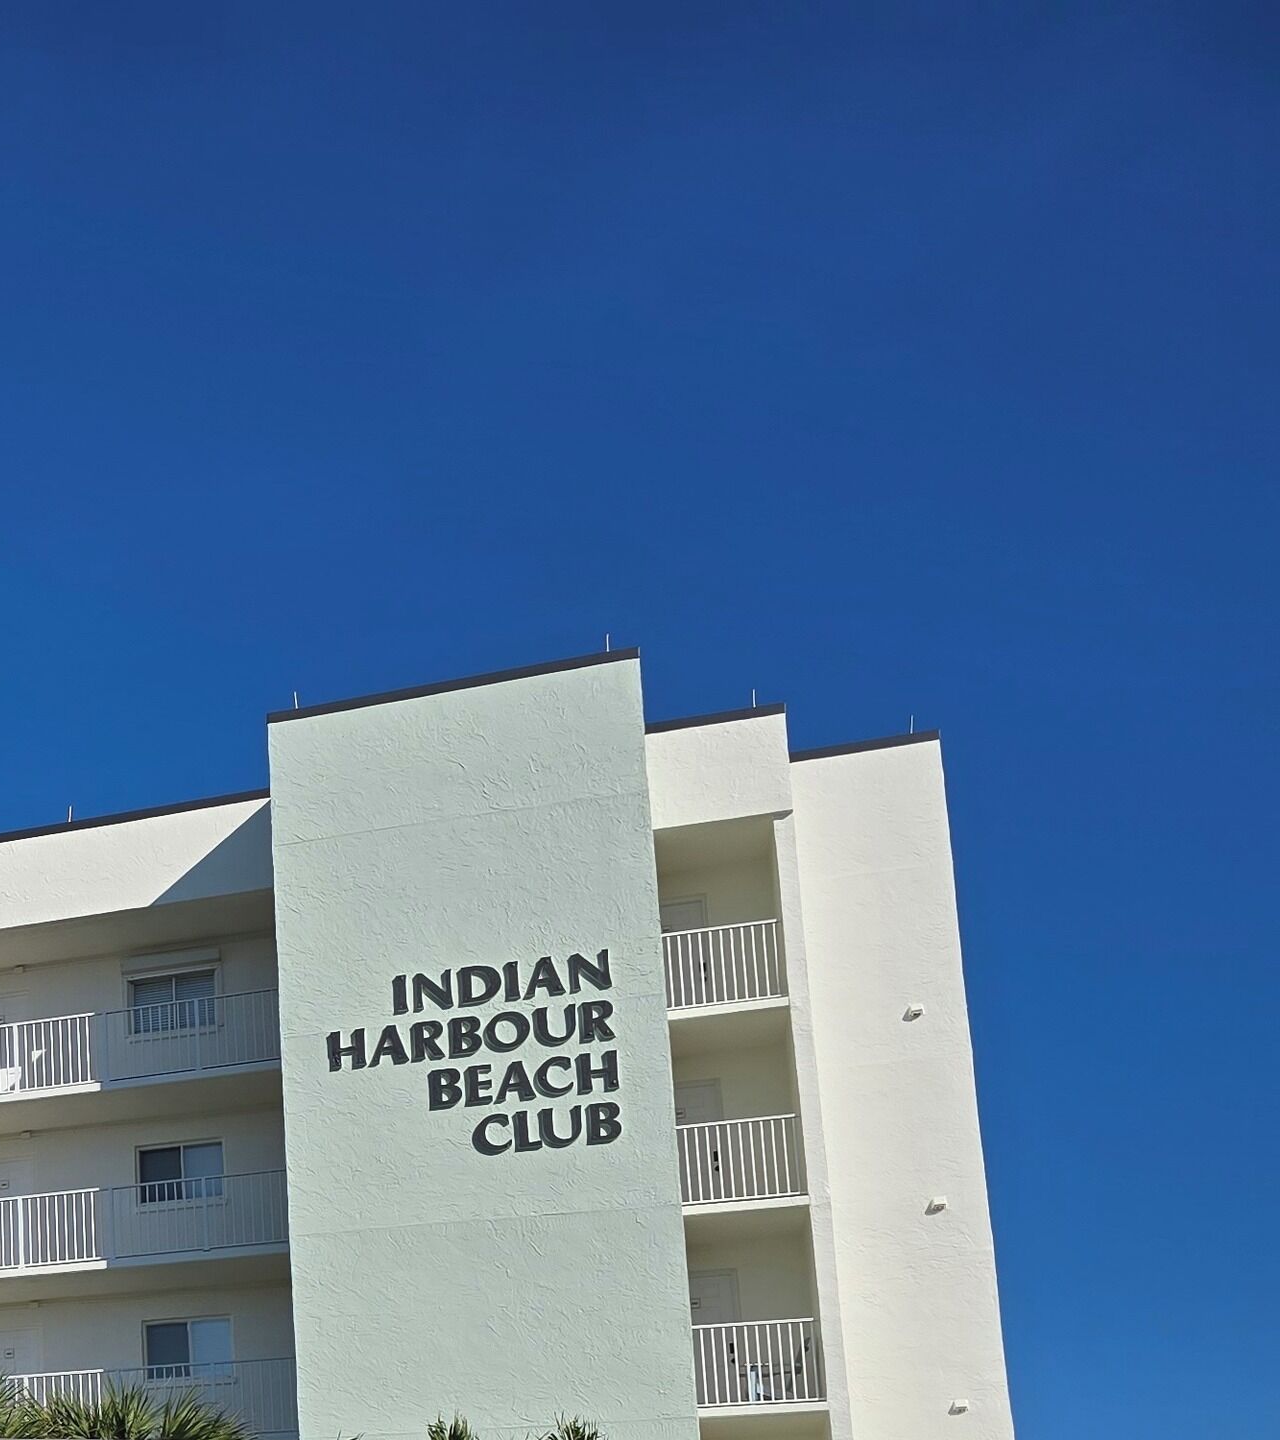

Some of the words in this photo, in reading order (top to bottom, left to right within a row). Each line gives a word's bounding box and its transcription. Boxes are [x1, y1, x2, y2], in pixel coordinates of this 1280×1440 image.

[392, 949, 612, 1016] INDIAN
[326, 1000, 616, 1072] HARBOUR
[427, 1050, 620, 1111] BEACH
[472, 1101, 622, 1156] CLUB
